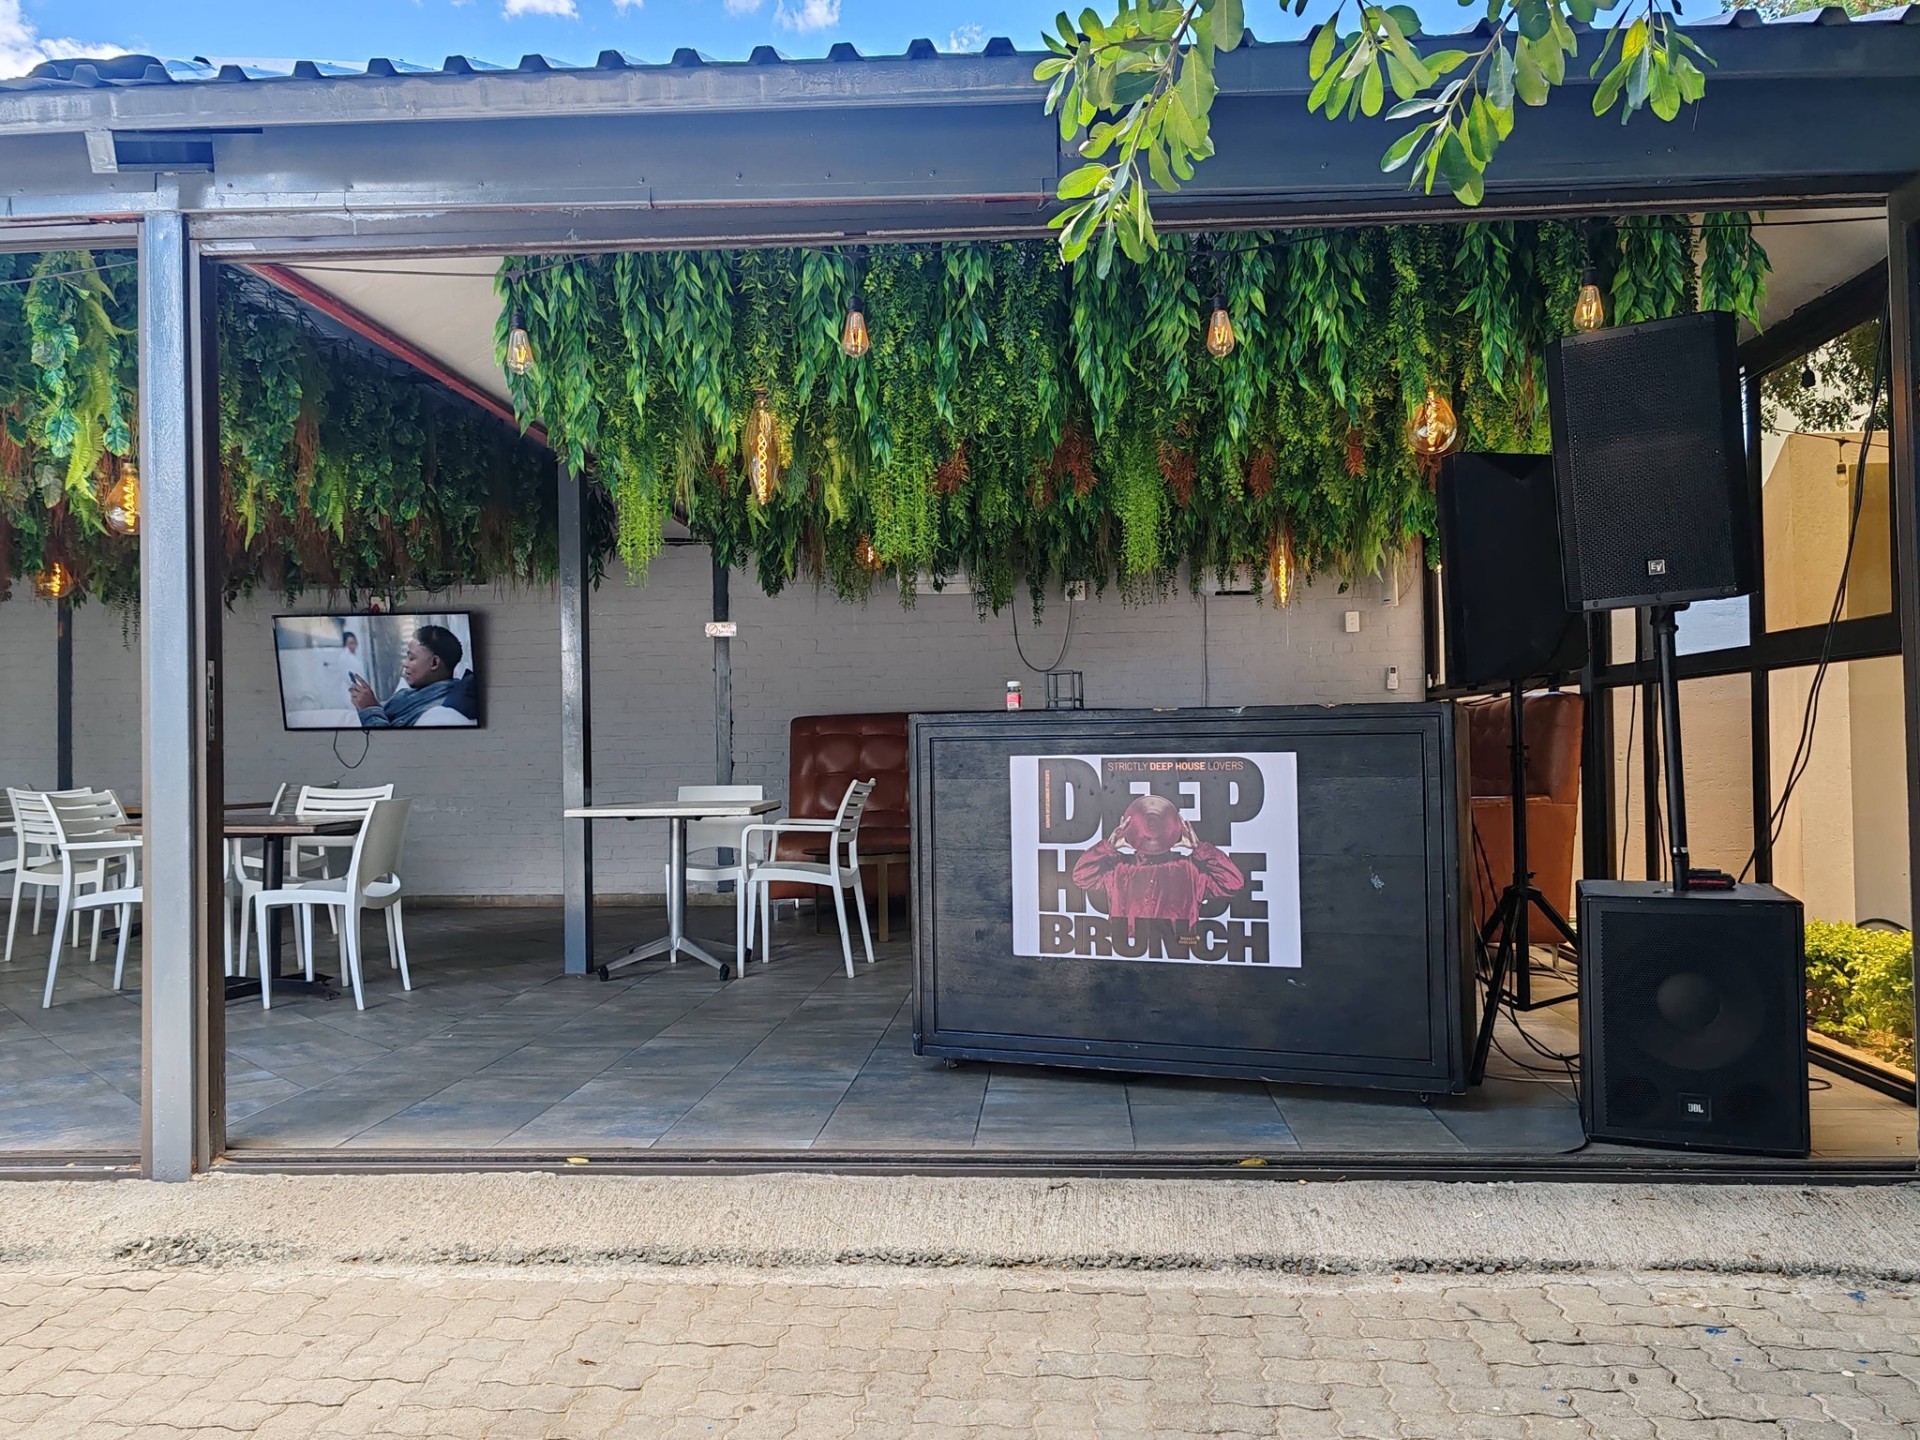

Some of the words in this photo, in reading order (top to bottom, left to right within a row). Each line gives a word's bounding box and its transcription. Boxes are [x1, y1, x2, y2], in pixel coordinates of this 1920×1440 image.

[1107, 762, 1149, 771] STRICTLY
[1150, 762, 1173, 771] DEEP
[1175, 762, 1206, 771] HOUSE
[1208, 761, 1244, 771] LOVERS
[1038, 756, 1265, 846] DEEP
[1039, 914, 1270, 963] BRUNCH
[1688, 1103, 1704, 1113] JBL
